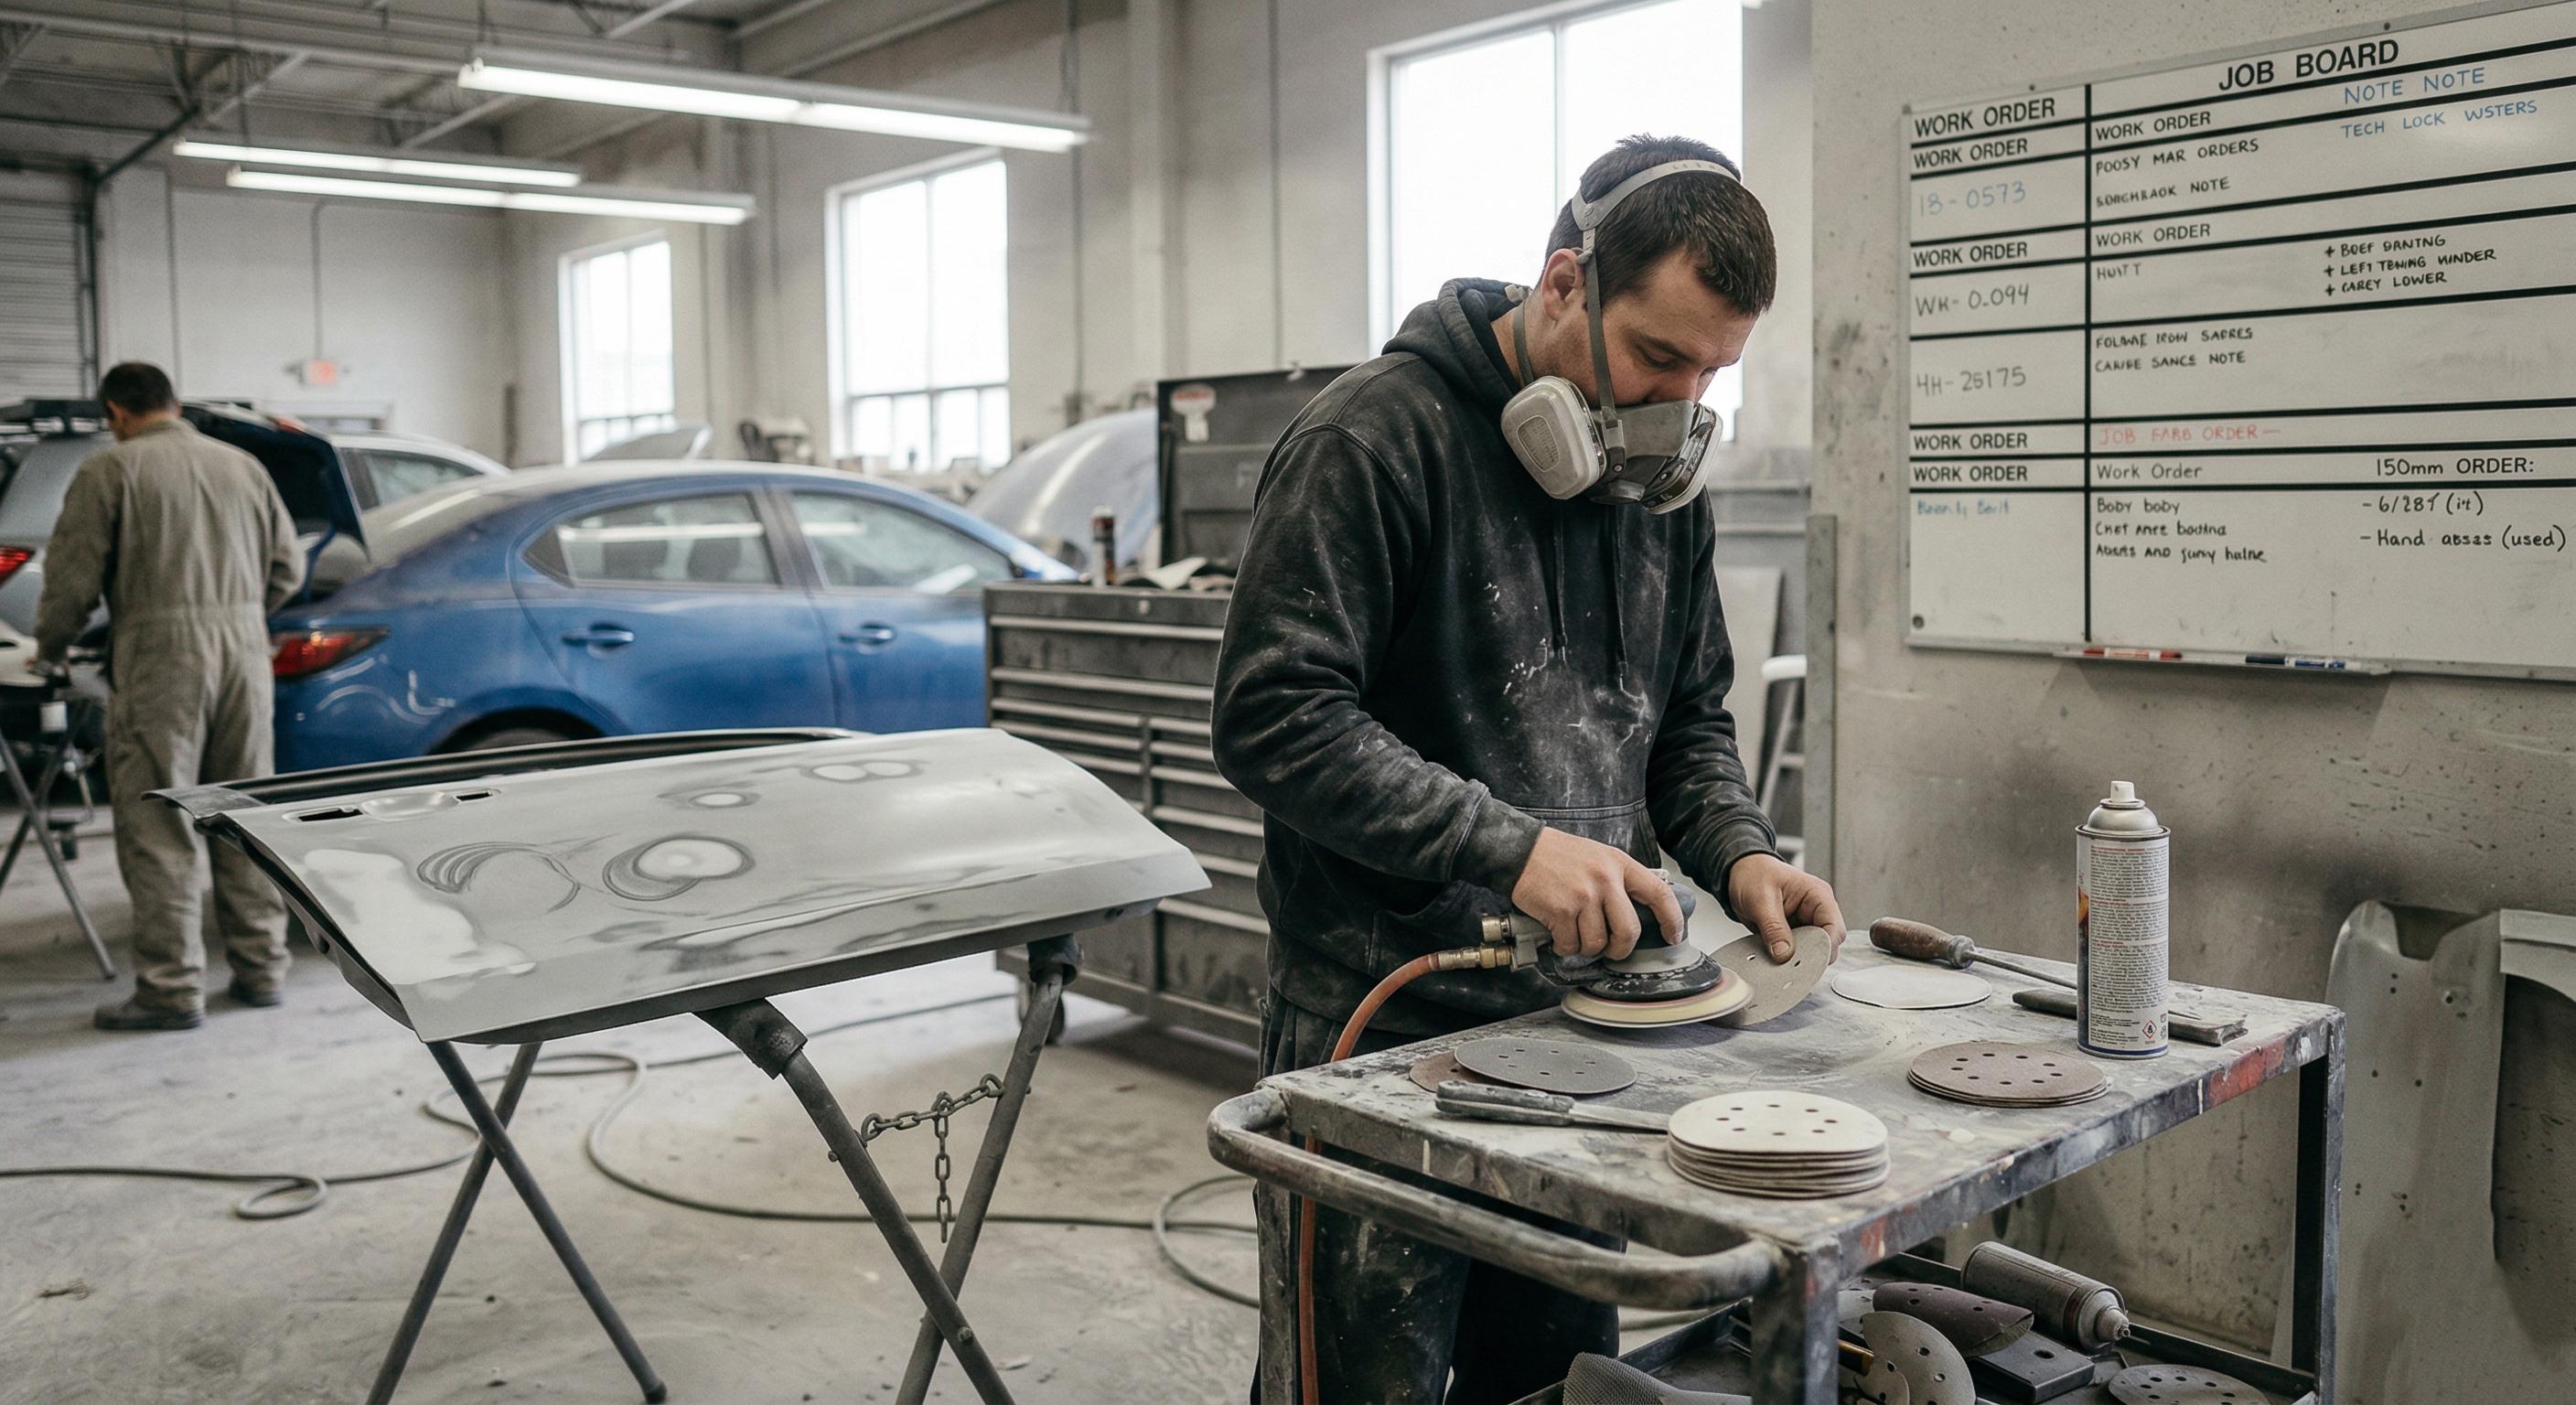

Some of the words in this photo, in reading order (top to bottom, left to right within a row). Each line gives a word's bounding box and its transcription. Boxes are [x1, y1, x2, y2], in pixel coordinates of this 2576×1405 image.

[2219, 60, 2274, 91] JOB
[2296, 39, 2399, 78] BOARD
[2345, 80, 2404, 104] NOTE
[2424, 67, 2485, 92] NOTE
[1915, 109, 1973, 137] WORK
[1983, 97, 2055, 126] ORDER
[2096, 121, 2144, 141] WORK
[2153, 111, 2211, 133] ORDER
[2341, 120, 2385, 138] TECH
[2403, 112, 2446, 130] LOCK
[1914, 146, 1962, 168] WORK
[1970, 138, 2028, 161] ORDER
[2153, 149, 2186, 166] MAR
[2197, 138, 2259, 158] ORDERS
[2190, 177, 2230, 194] NOTE
[2096, 230, 2143, 248] WORK
[2153, 223, 2211, 242] ORDER
[1914, 247, 1963, 267] WORK
[1970, 241, 2028, 263] ORDER
[2393, 271, 2448, 288] LOWER
[2209, 350, 2247, 365] NOTE
[1914, 434, 1962, 451] WORK
[1970, 433, 2028, 449] ORDER
[2099, 426, 2136, 445] JOB
[1914, 466, 1962, 482] WORK
[1970, 466, 2028, 482] ORDER
[2097, 464, 2141, 479] Work
[2151, 462, 2203, 479] Order
[2377, 458, 2443, 477] 150mm
[2456, 457, 2534, 474] ORDER:
[2377, 529, 2425, 547] Hand
[2502, 524, 2566, 552] (used)
